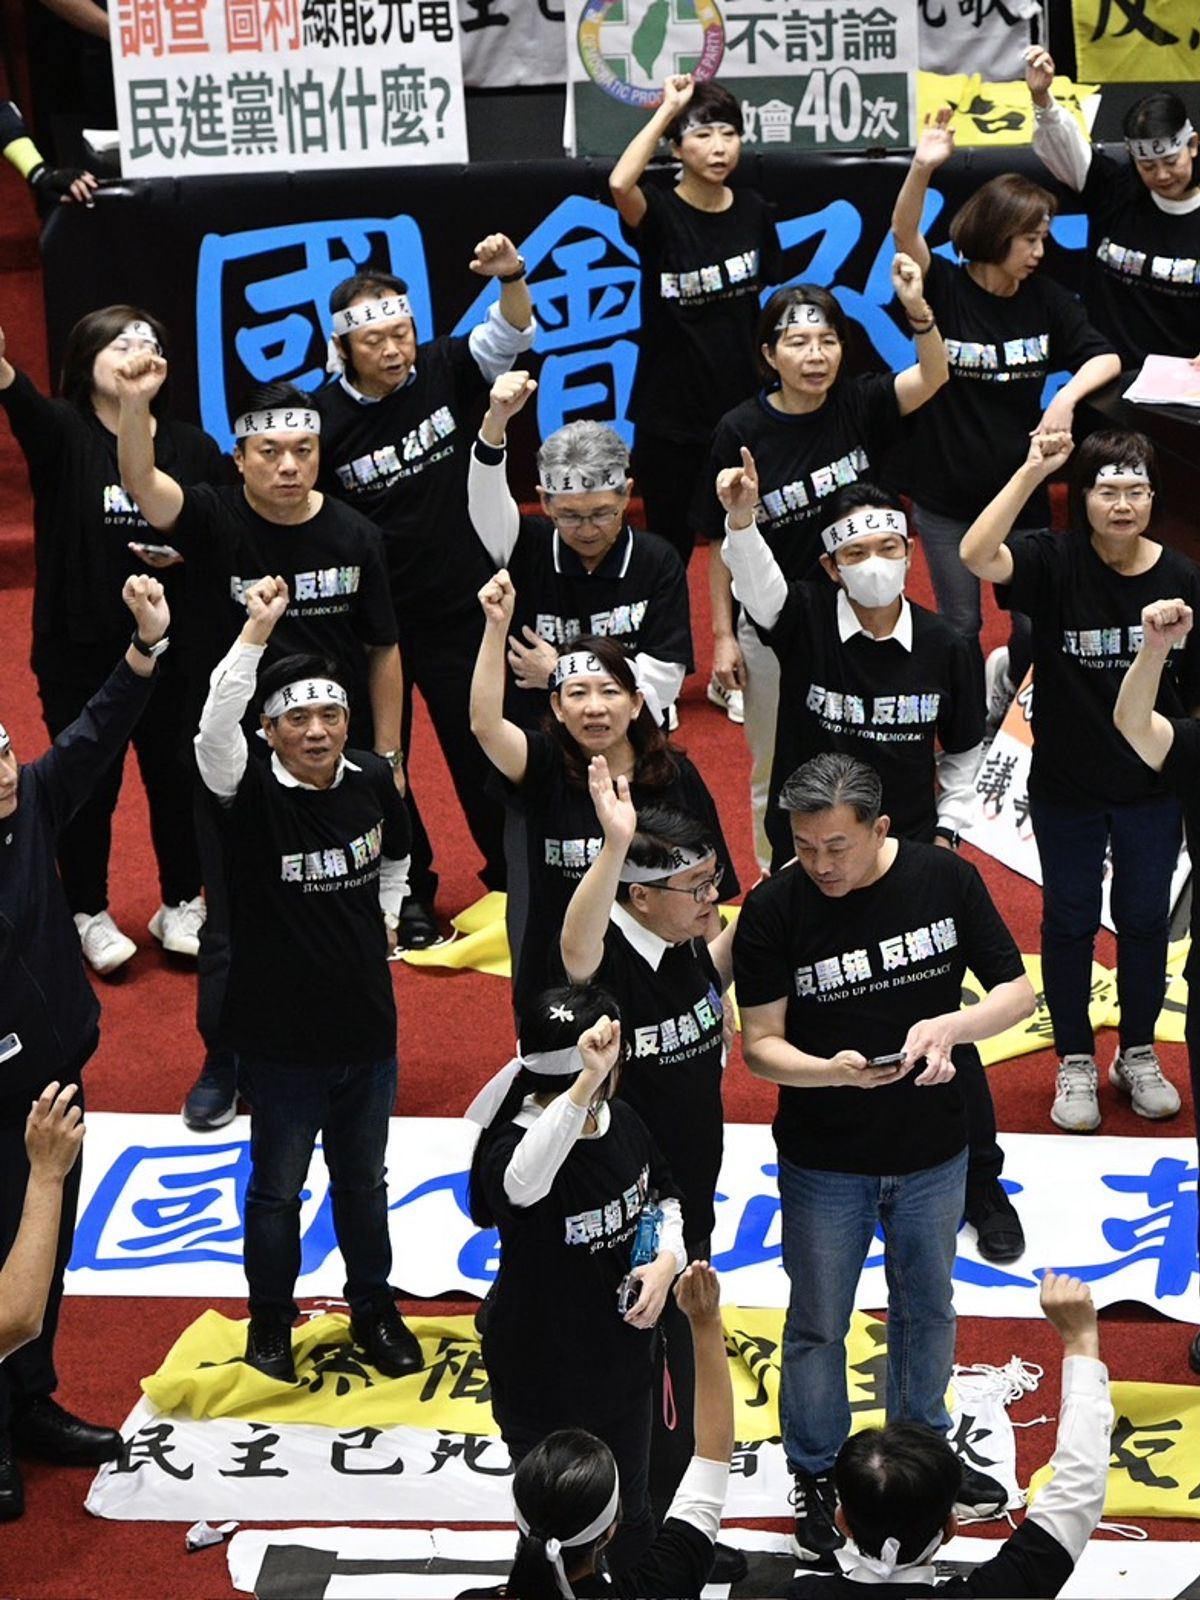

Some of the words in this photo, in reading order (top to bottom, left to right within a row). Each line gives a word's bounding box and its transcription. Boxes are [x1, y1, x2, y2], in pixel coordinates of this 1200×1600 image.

[726, 6, 898, 64] 不討論
[128, 64, 452, 160] 民進黨怕什麼?
[830, 512, 899, 546] 民主已死
[806, 683, 865, 725] 反黑箱
[872, 693, 941, 725] 反擴權
[281, 848, 349, 883] 反黑箱
[795, 948, 872, 998] 反黑箱
[879, 917, 958, 972] 反擴權
[817, 989, 849, 1003] STAND
[853, 985, 867, 997] UP
[869, 979, 891, 994] FOR
[892, 963, 952, 988] DEMOCRACY
[634, 1011, 701, 1060] 反黑箱
[565, 1198, 622, 1245] 反黑箱
[108, 1423, 515, 1481] 民主已死
